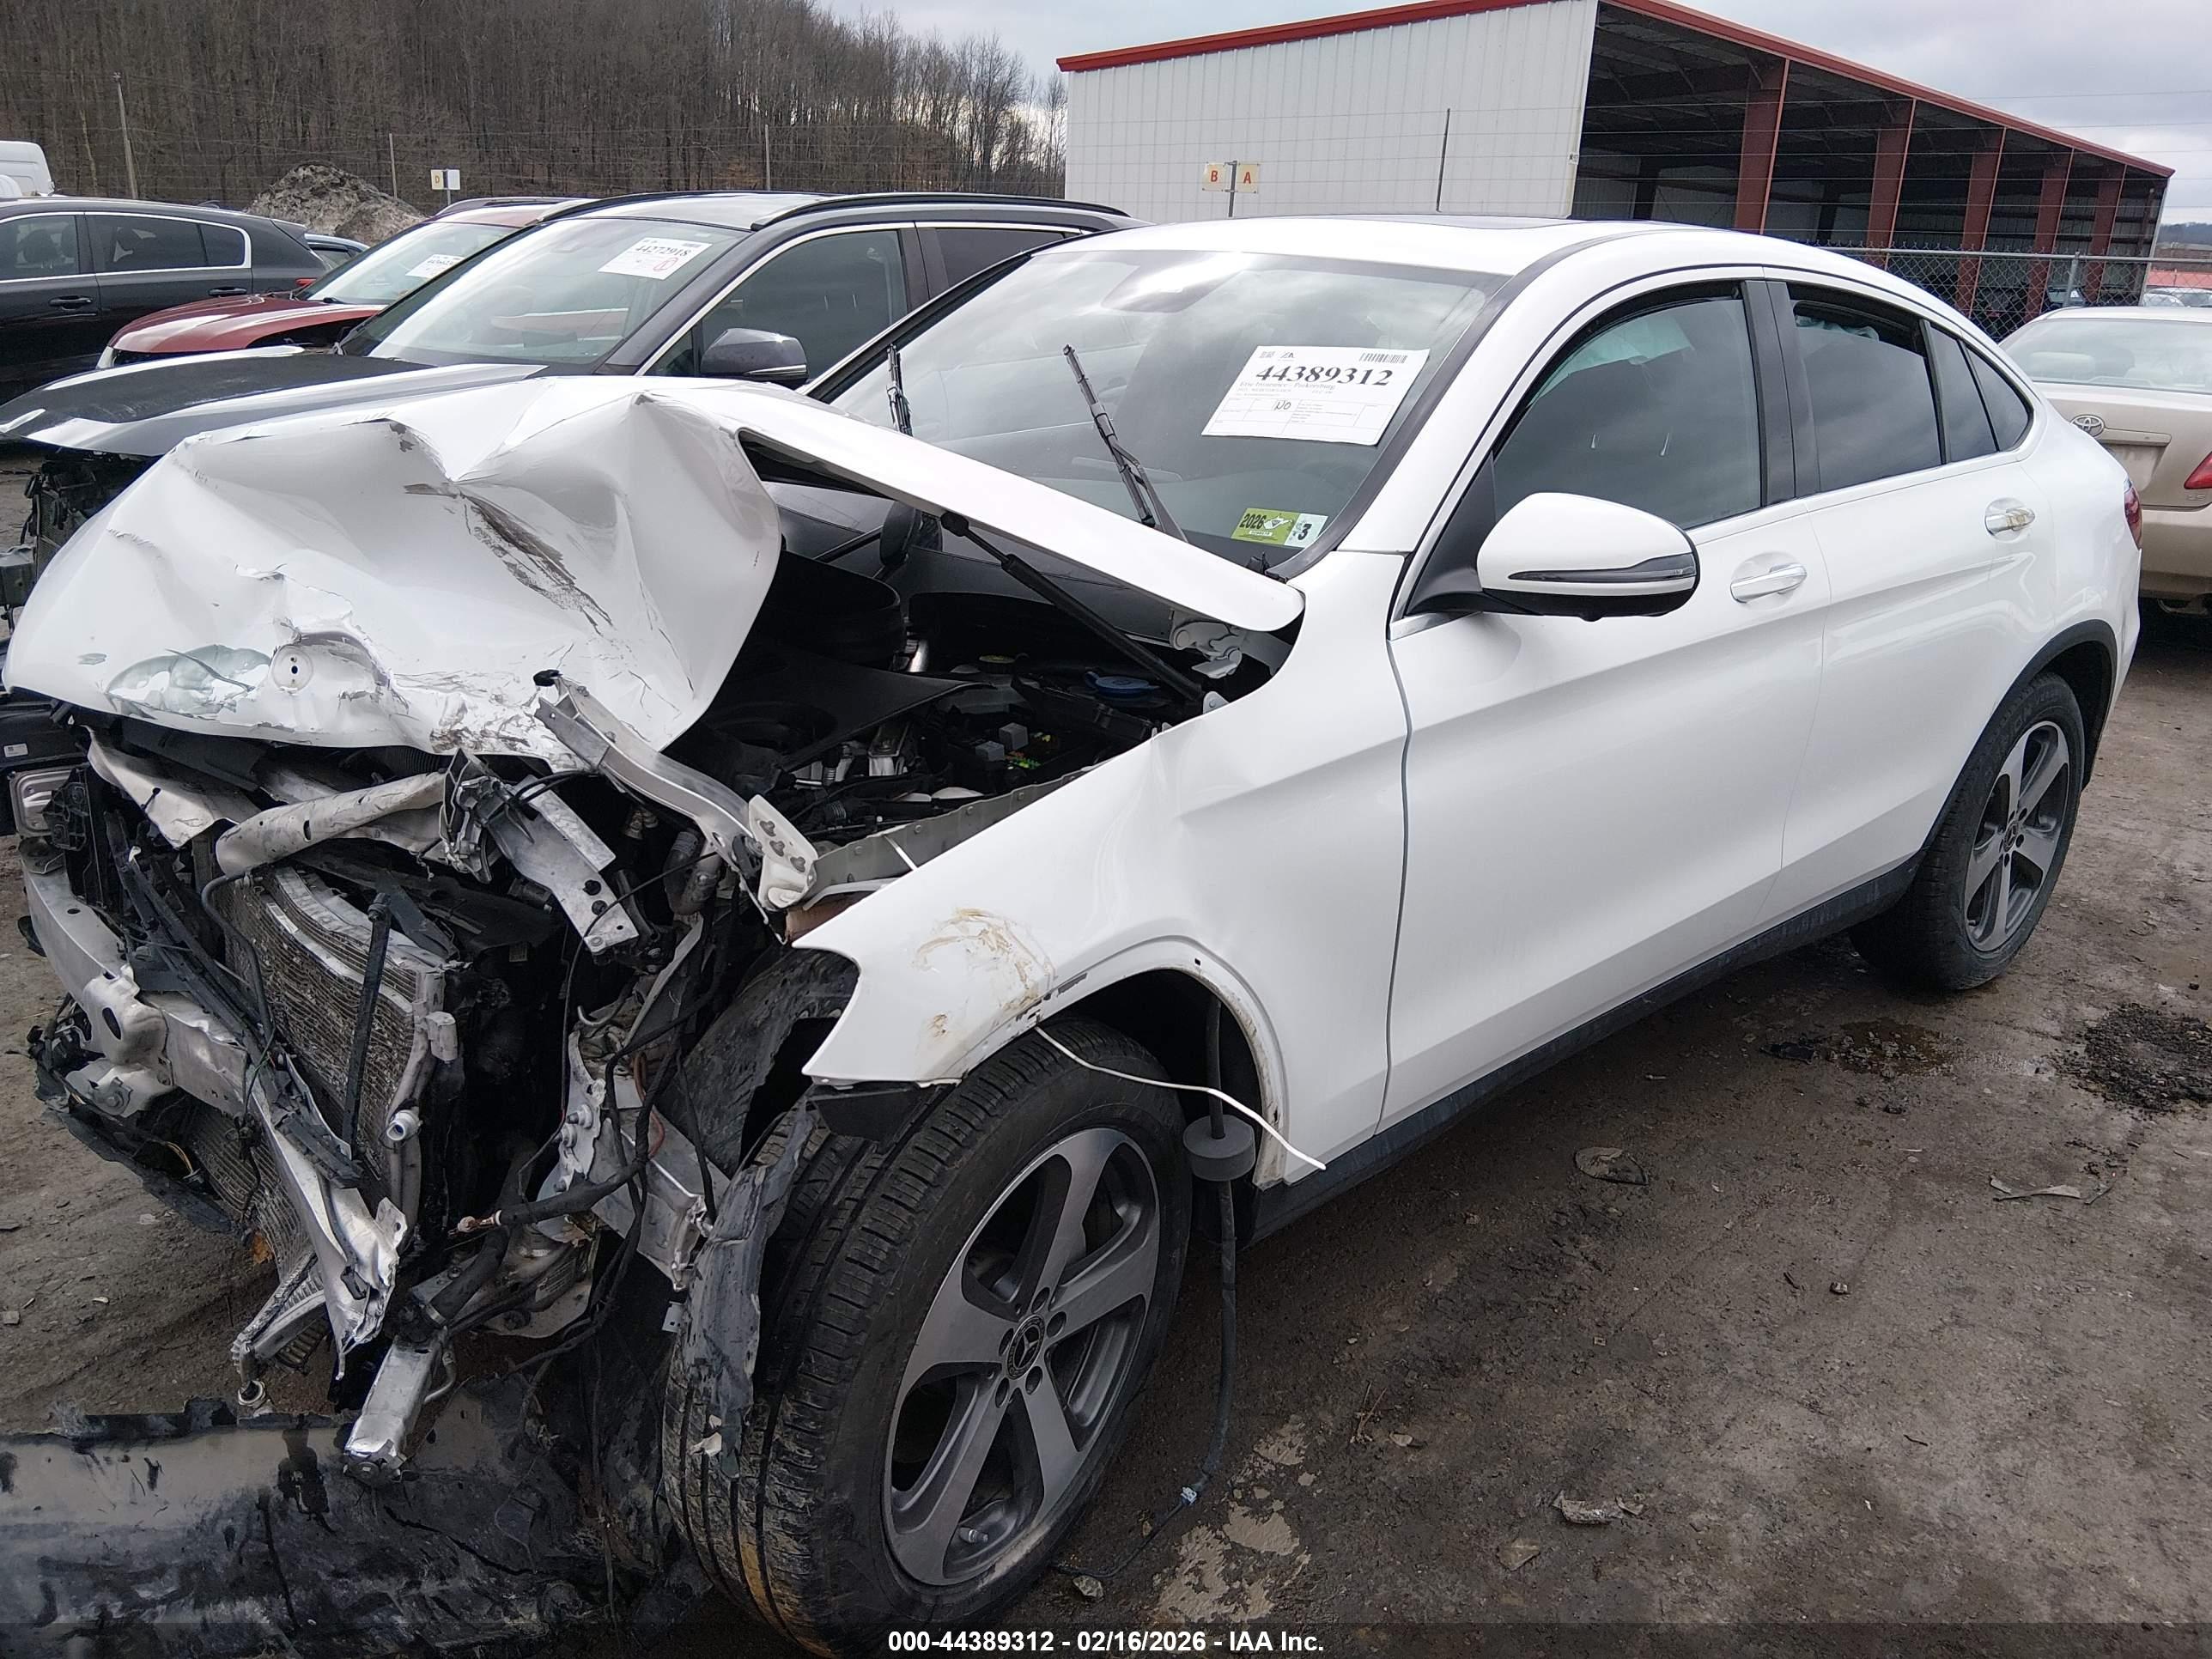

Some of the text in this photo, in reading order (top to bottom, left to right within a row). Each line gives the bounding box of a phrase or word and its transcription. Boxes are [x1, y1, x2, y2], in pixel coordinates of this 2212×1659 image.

[1211, 171, 1218, 182] B
[1243, 172, 1251, 184] A
[635, 246, 691, 256] 44272918
[1256, 365, 1393, 386] 44389312
[1239, 514, 1267, 530] 2026
[1298, 523, 1312, 540] 3
